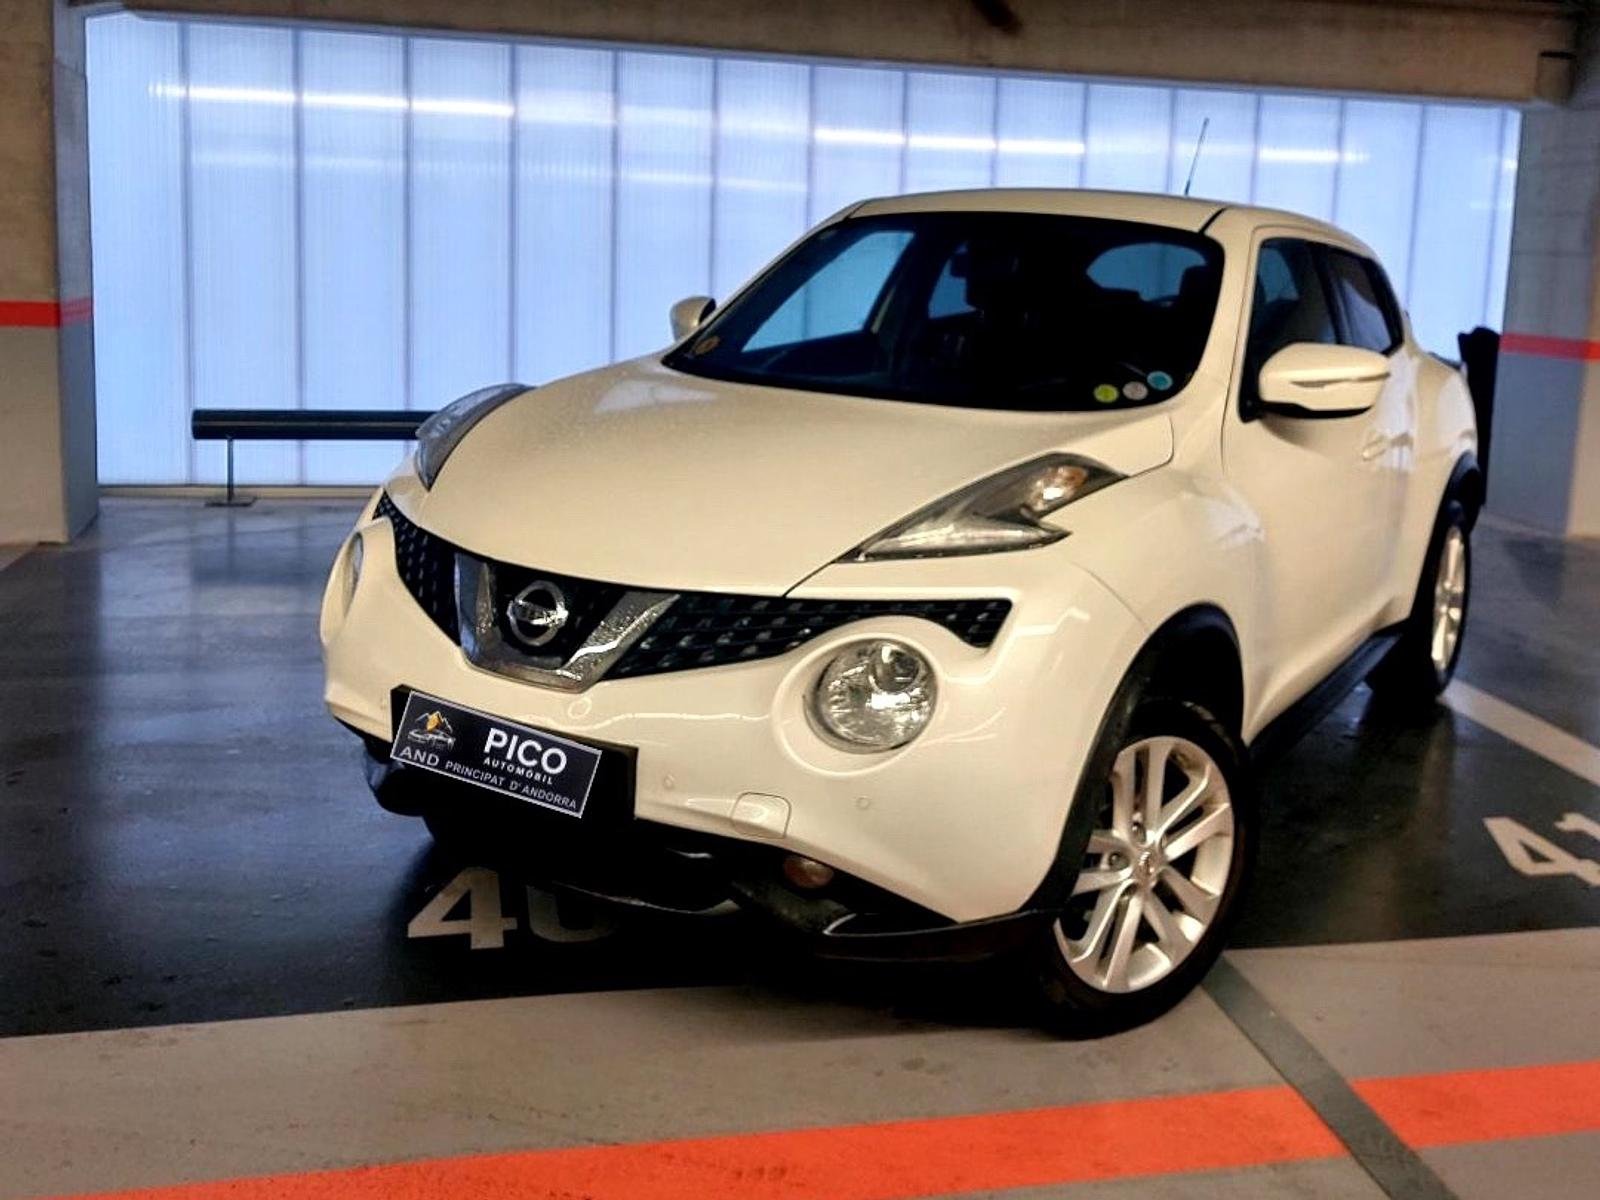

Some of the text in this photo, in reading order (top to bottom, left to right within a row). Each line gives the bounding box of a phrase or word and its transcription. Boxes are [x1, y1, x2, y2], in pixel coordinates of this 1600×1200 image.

[400, 746, 440, 766] AND
[445, 761, 505, 785] PRINCIPAT
[483, 728, 567, 775] PICO
